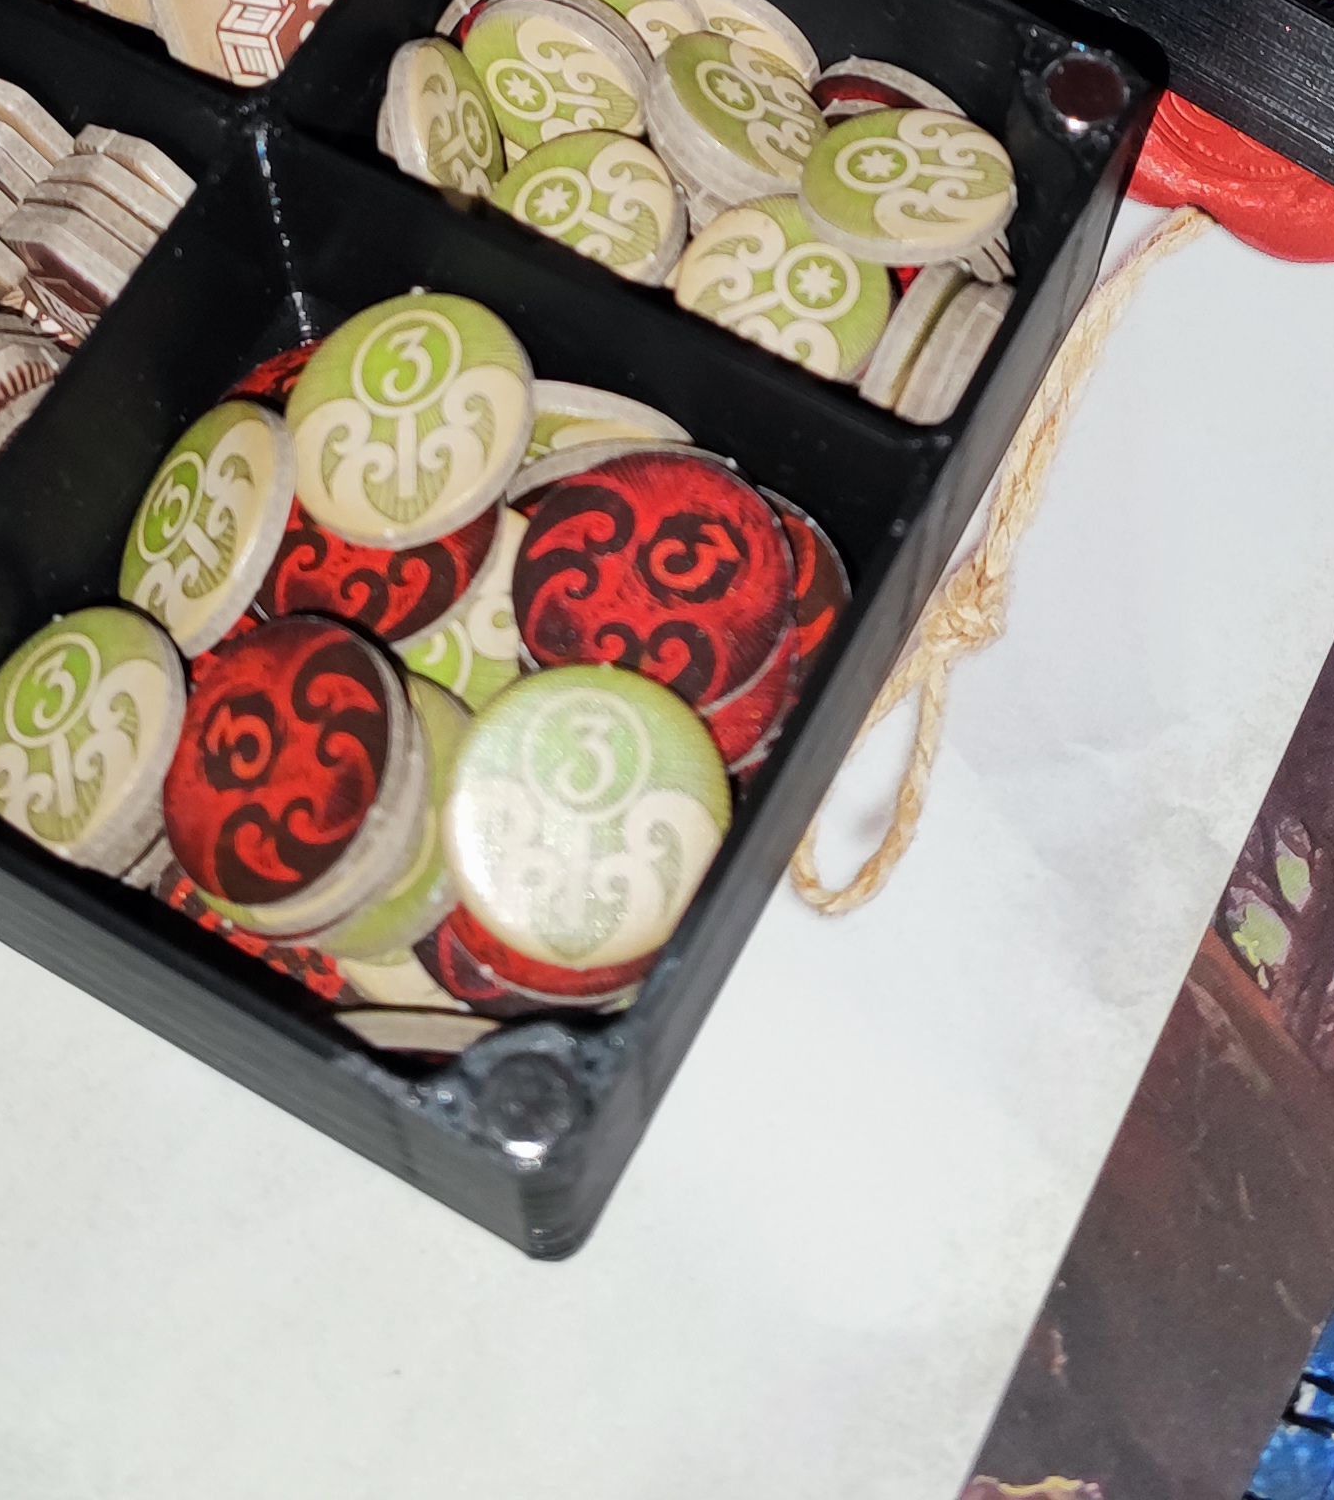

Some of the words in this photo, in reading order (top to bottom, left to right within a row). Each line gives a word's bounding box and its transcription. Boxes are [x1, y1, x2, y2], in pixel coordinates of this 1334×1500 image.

[380, 325, 435, 402] 3
[161, 473, 201, 535] 3
[33, 644, 77, 727] 3
[205, 702, 273, 781] 3
[554, 712, 617, 801] 3
